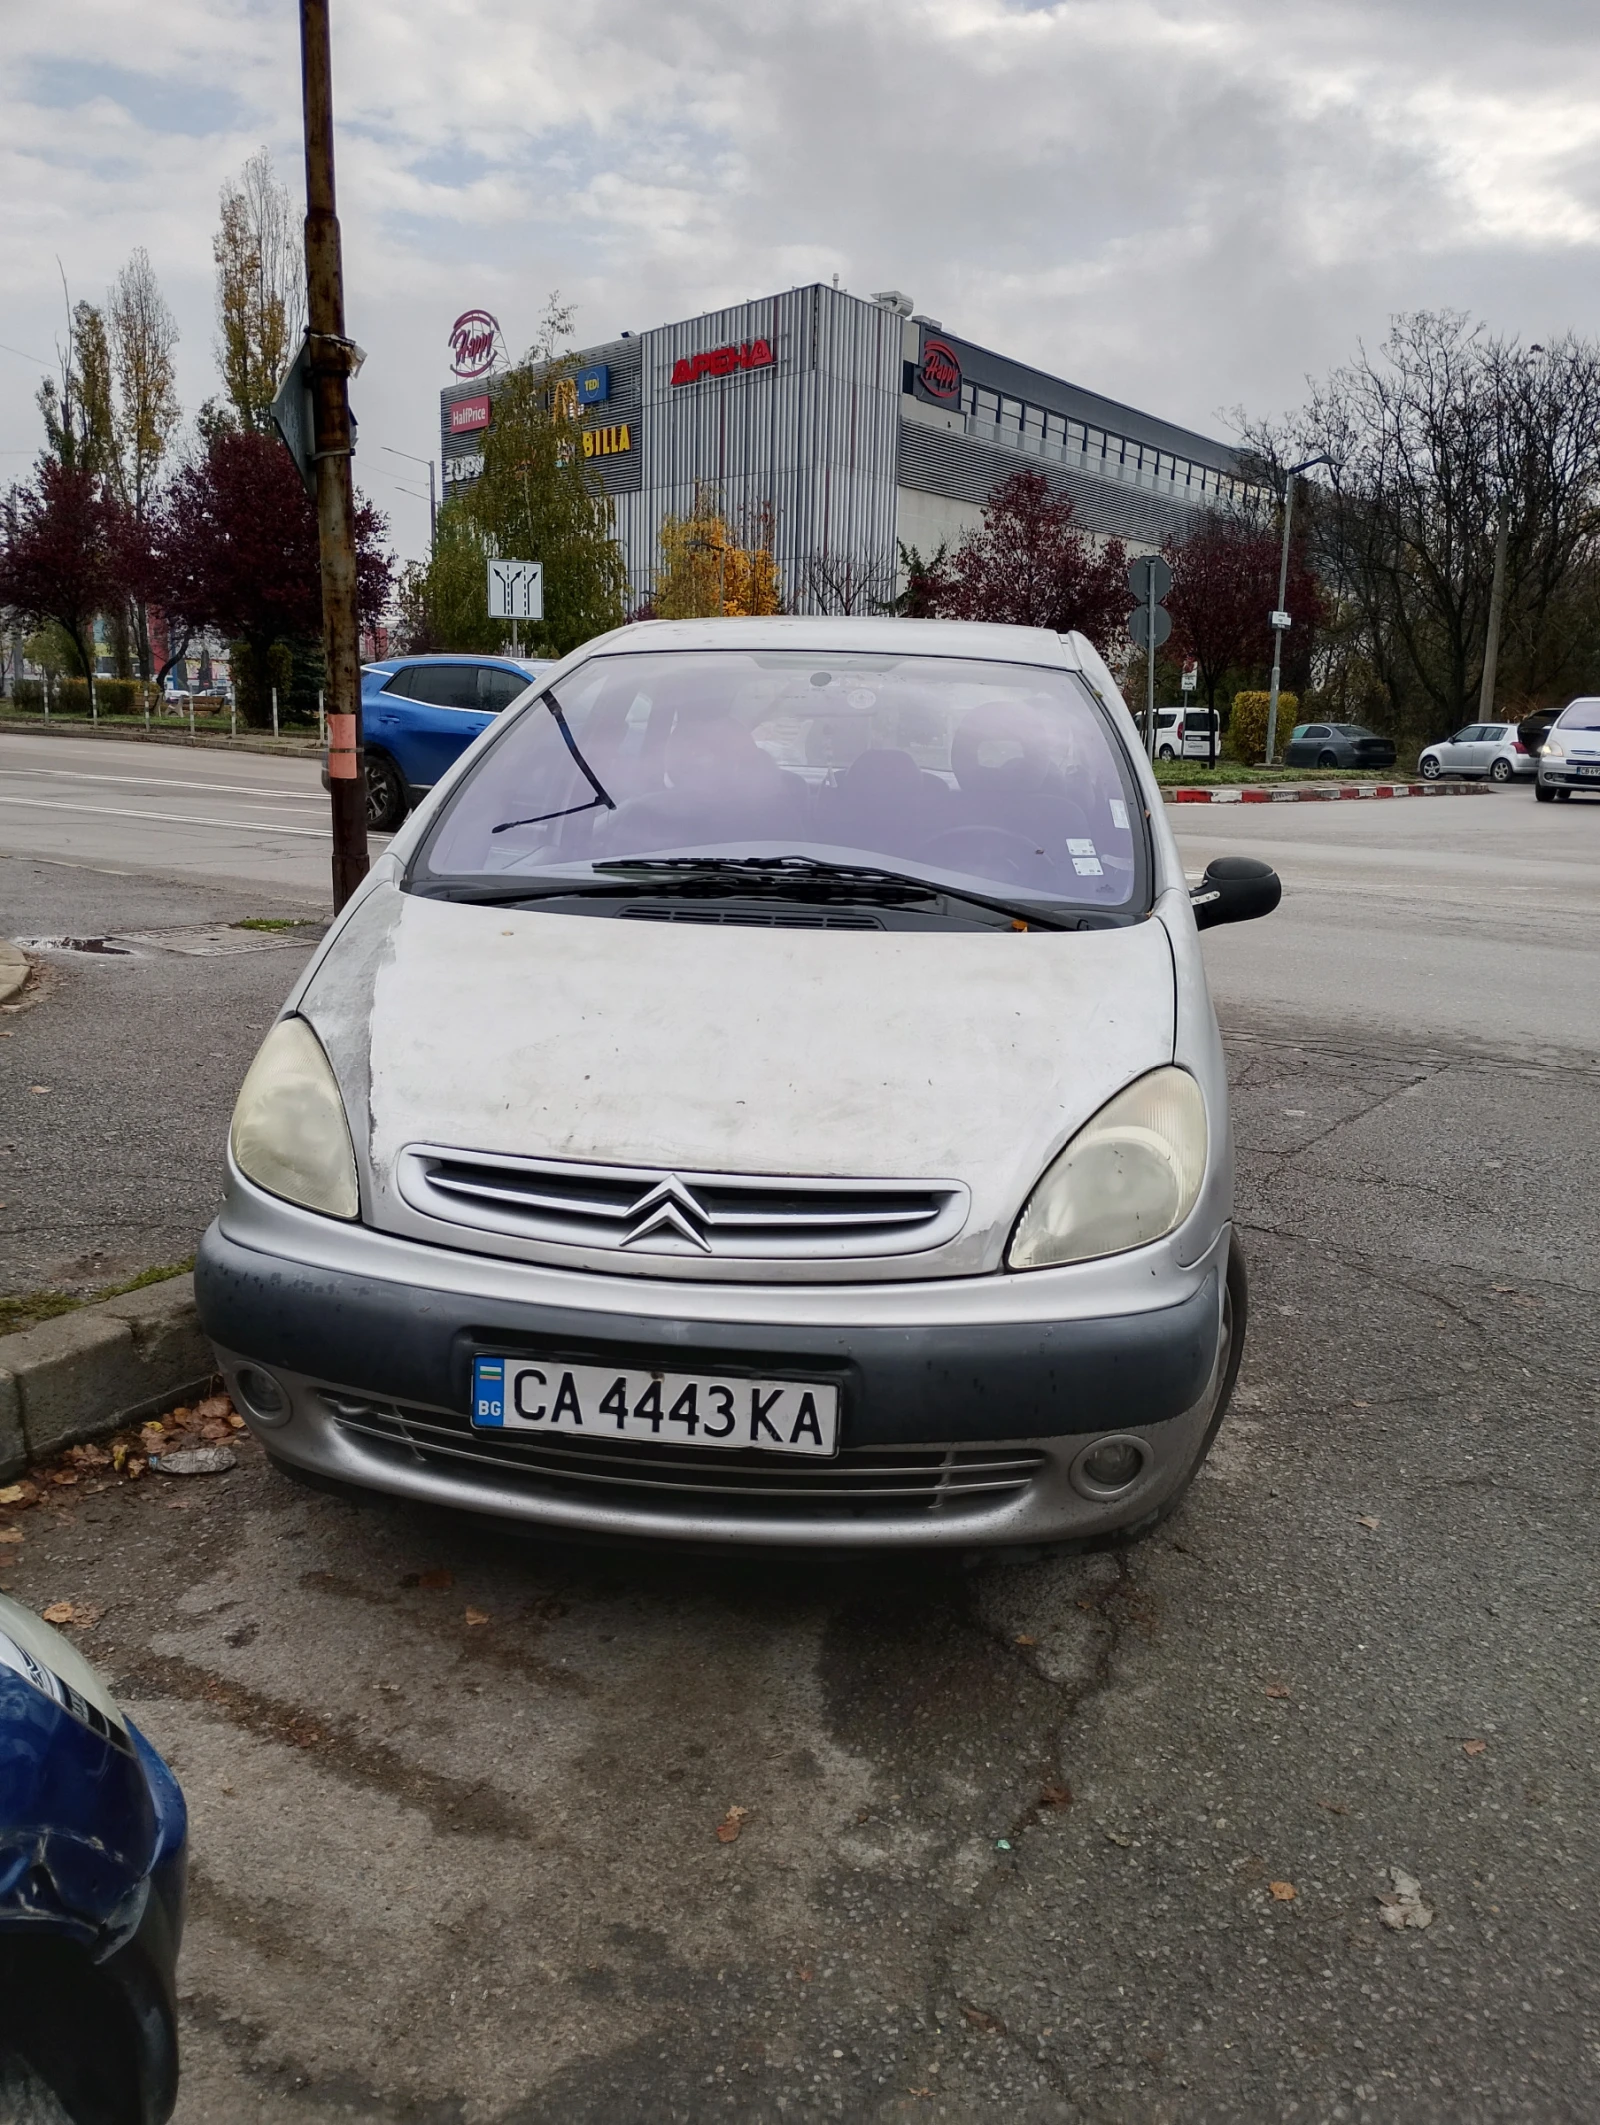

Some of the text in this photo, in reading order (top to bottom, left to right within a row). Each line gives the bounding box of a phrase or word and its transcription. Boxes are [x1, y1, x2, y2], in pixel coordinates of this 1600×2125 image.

[453, 329, 494, 366] Happy
[671, 339, 772, 385] АРЕНА
[924, 353, 958, 389] Happy
[453, 407, 486, 426] HalfPrice
[582, 424, 631, 457] BILLA
[478, 1400, 501, 1417] BG
[513, 1369, 823, 1446] CA 4443 KA
